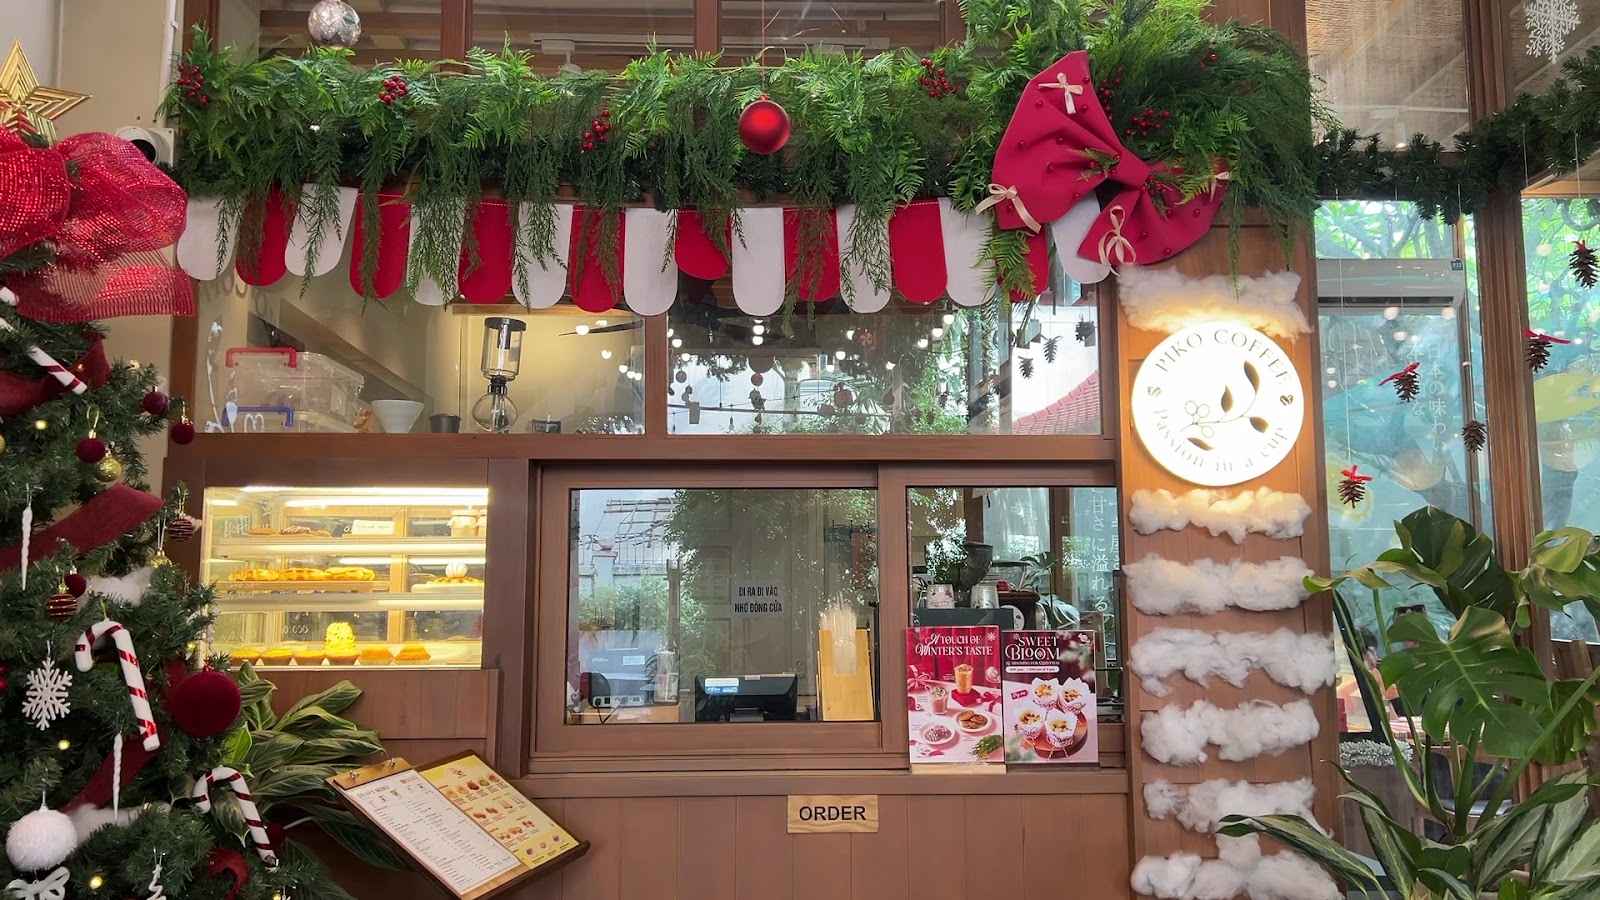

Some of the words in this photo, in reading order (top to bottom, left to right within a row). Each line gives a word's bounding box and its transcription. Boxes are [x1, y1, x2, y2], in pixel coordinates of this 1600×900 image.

[1155, 332, 1203, 372] PIKO
[1213, 329, 1292, 384] COFFEE
[1153, 409, 1204, 467] Passion
[1215, 457, 1233, 471] in
[1245, 457, 1254, 468] a
[1260, 427, 1289, 457] cup
[747, 586, 756, 597] RA
[757, 586, 764, 597] ĐI
[765, 585, 779, 597] VÀO
[750, 601, 768, 613] ĐÓNG
[769, 600, 783, 613] CỬA
[925, 633, 941, 645] A
[940, 634, 968, 645] TOUCH
[969, 635, 982, 644] OF
[1018, 636, 1059, 647] SWEET
[915, 643, 963, 656] WINTER'S
[963, 646, 993, 656] TASTE
[1005, 644, 1061, 660] BLOOM
[799, 806, 867, 821] ORDER
